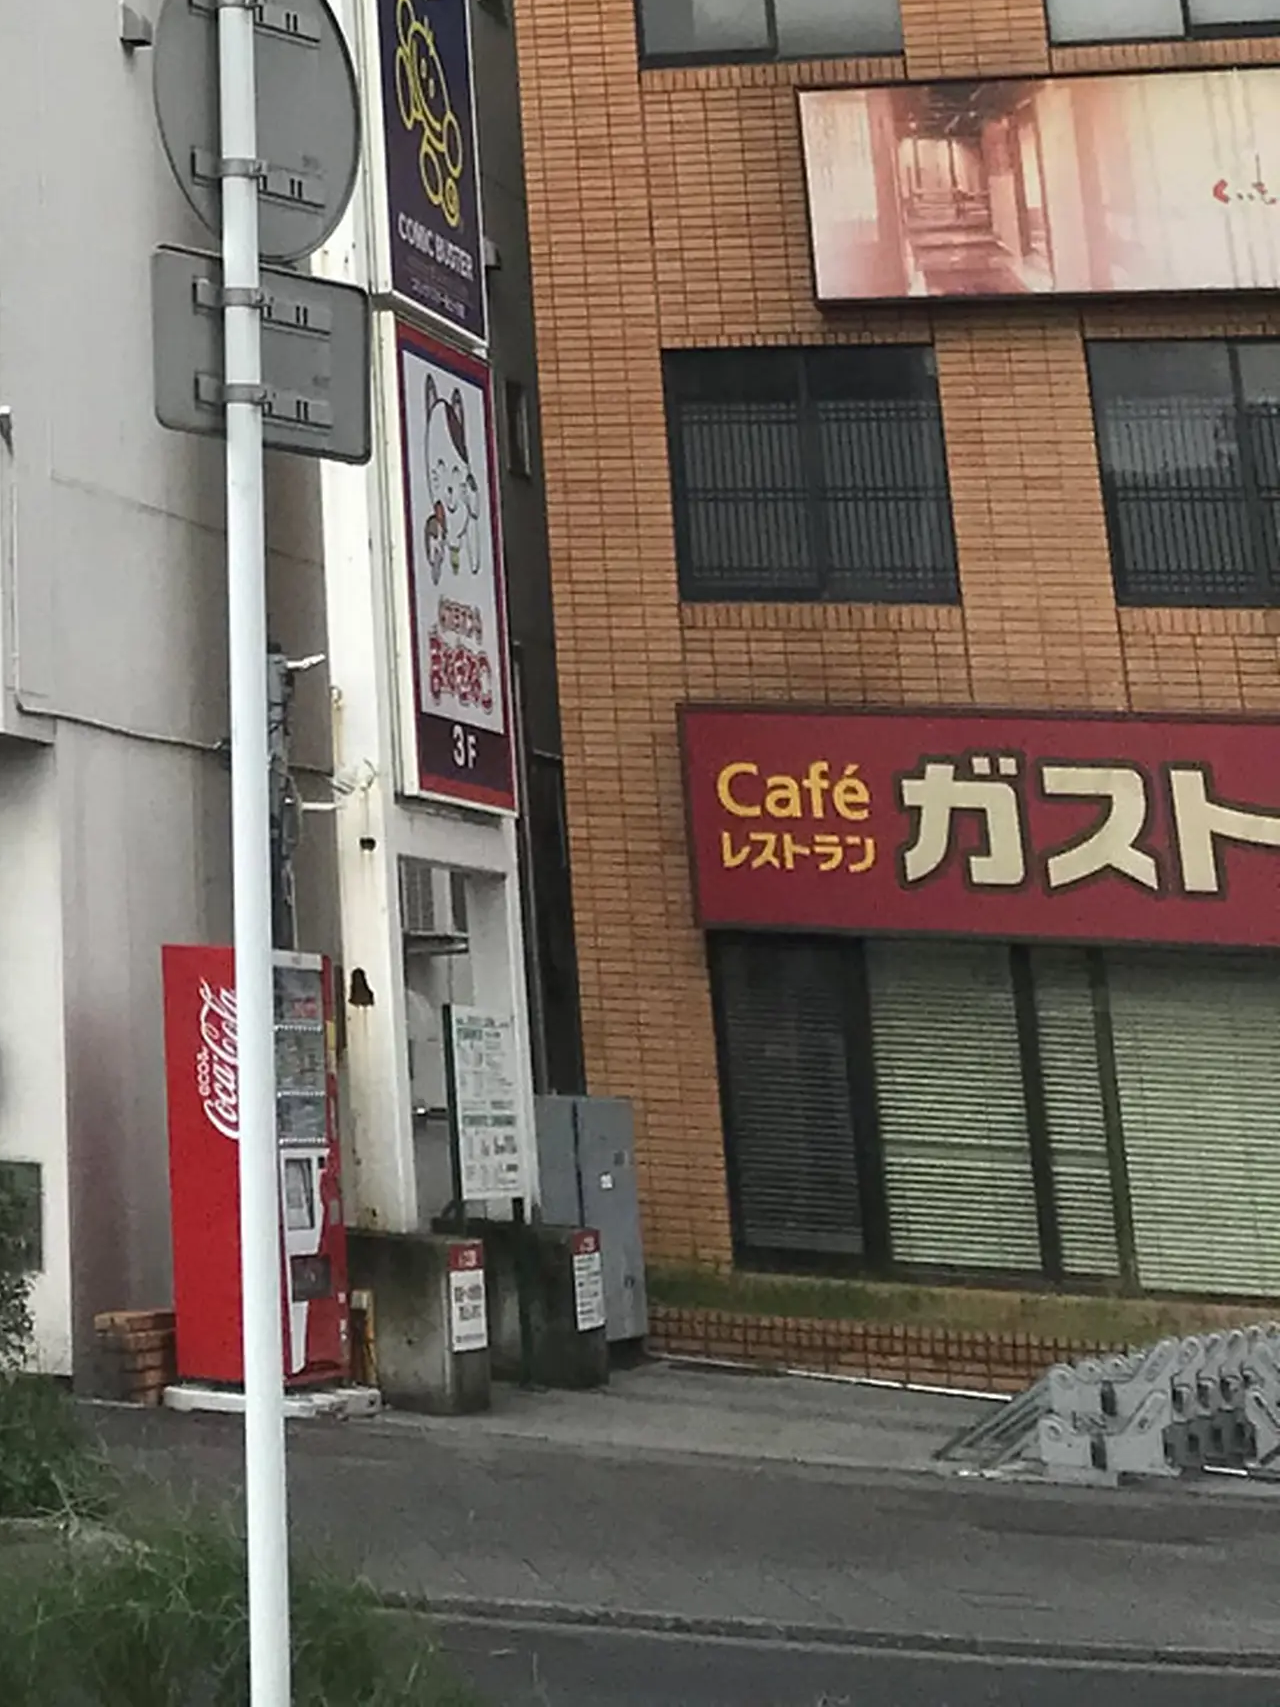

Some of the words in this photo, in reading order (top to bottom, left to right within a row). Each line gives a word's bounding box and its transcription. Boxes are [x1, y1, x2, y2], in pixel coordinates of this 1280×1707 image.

[451, 724, 478, 769] 3F
[716, 760, 873, 822] Café
[900, 755, 1280, 893] ガスト
[721, 831, 877, 872] レストラン
